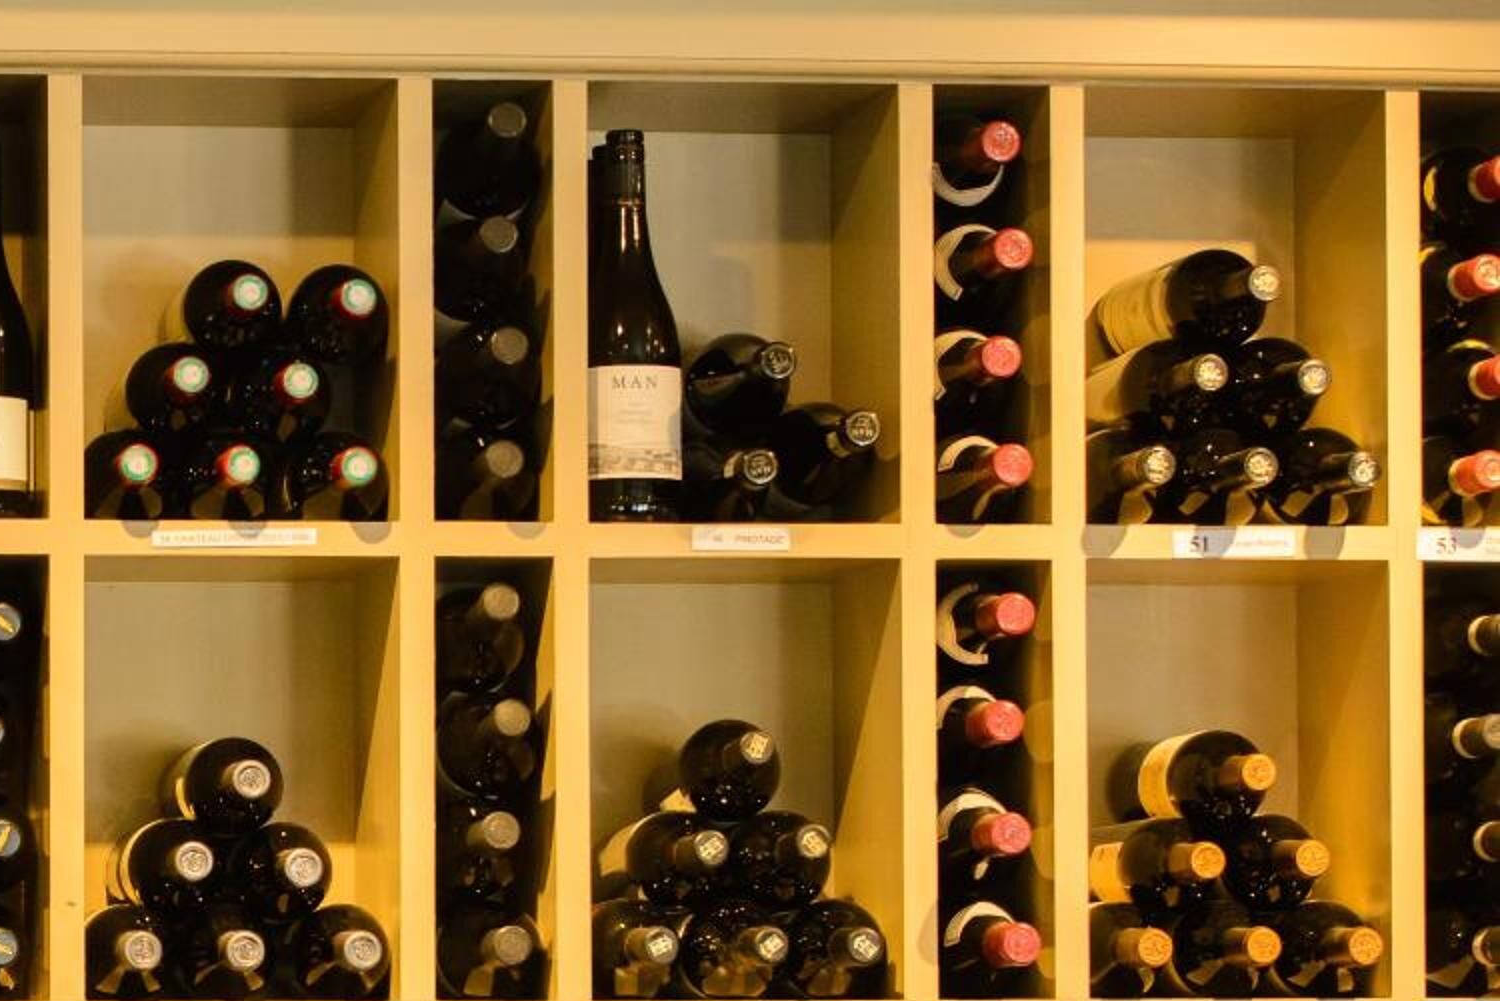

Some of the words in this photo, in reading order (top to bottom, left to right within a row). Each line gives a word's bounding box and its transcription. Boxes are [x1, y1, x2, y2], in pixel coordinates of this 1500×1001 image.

[611, 375, 657, 389] MAN
[1188, 535, 1208, 552] 51
[1434, 537, 1456, 554] 53
